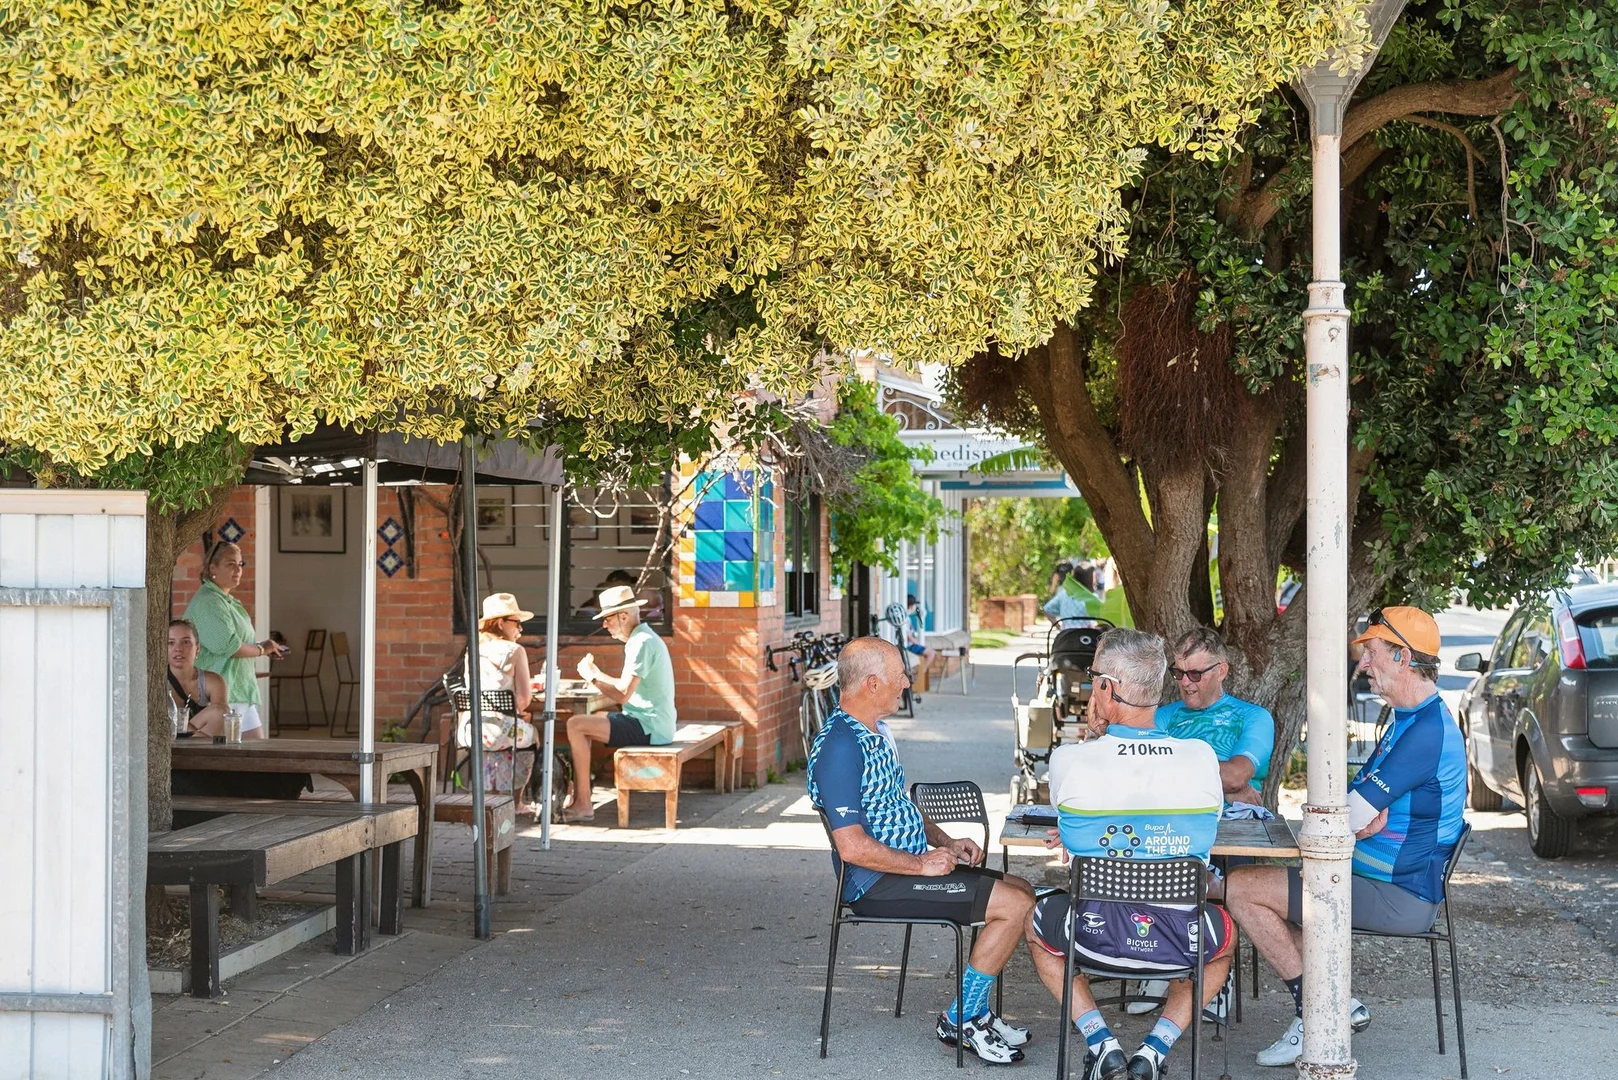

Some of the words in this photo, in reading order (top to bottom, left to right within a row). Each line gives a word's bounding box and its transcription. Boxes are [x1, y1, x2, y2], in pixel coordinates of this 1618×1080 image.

[1117, 744, 1173, 756] 210km
[1144, 824, 1164, 832] Bupa
[1145, 835, 1190, 846] AROUND
[1145, 845, 1167, 855] THE
[1169, 845, 1190, 855] BAY
[1126, 937, 1159, 948] BICYCLE
[1130, 945, 1154, 953] NETWORK
